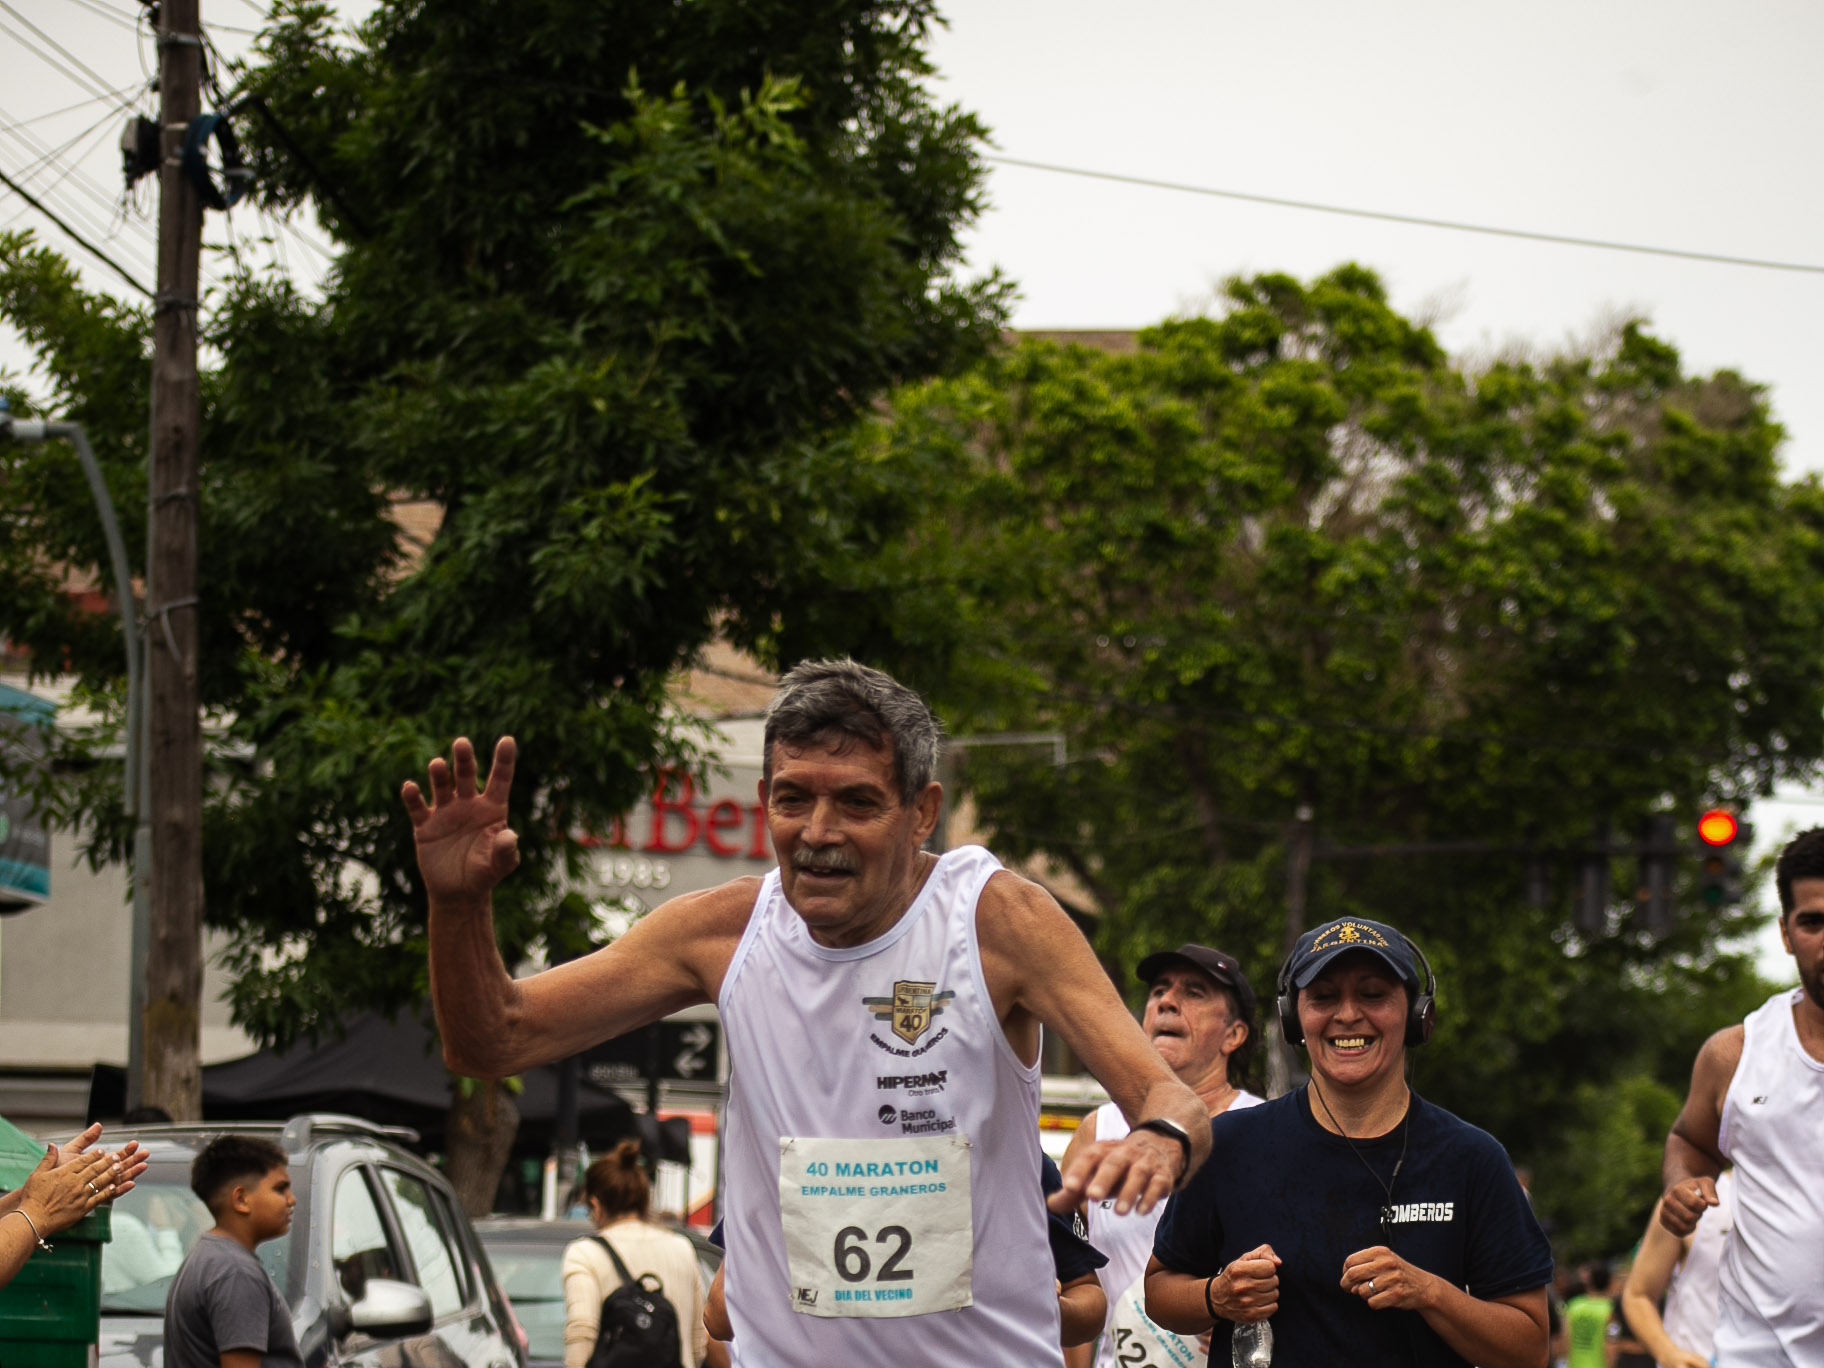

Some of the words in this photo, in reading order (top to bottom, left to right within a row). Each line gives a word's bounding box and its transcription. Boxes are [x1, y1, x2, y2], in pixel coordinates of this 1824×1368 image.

[899, 1014, 923, 1032] 40
[870, 1033, 911, 1058] EMPALME
[911, 1027, 949, 1057] GRANEROS
[900, 1110, 936, 1121] Banco
[901, 1116, 956, 1134] Municipal
[806, 1162, 828, 1176] 40
[836, 1160, 938, 1177] MARATON
[802, 1186, 865, 1196] EMPALME
[870, 1183, 947, 1197] GRANEROS
[1381, 1202, 1454, 1223] OMBEROS
[834, 1225, 914, 1282] 62
[835, 1290, 851, 1301] DIA
[855, 1289, 871, 1300] DEL
[875, 1288, 913, 1300] VECINO
